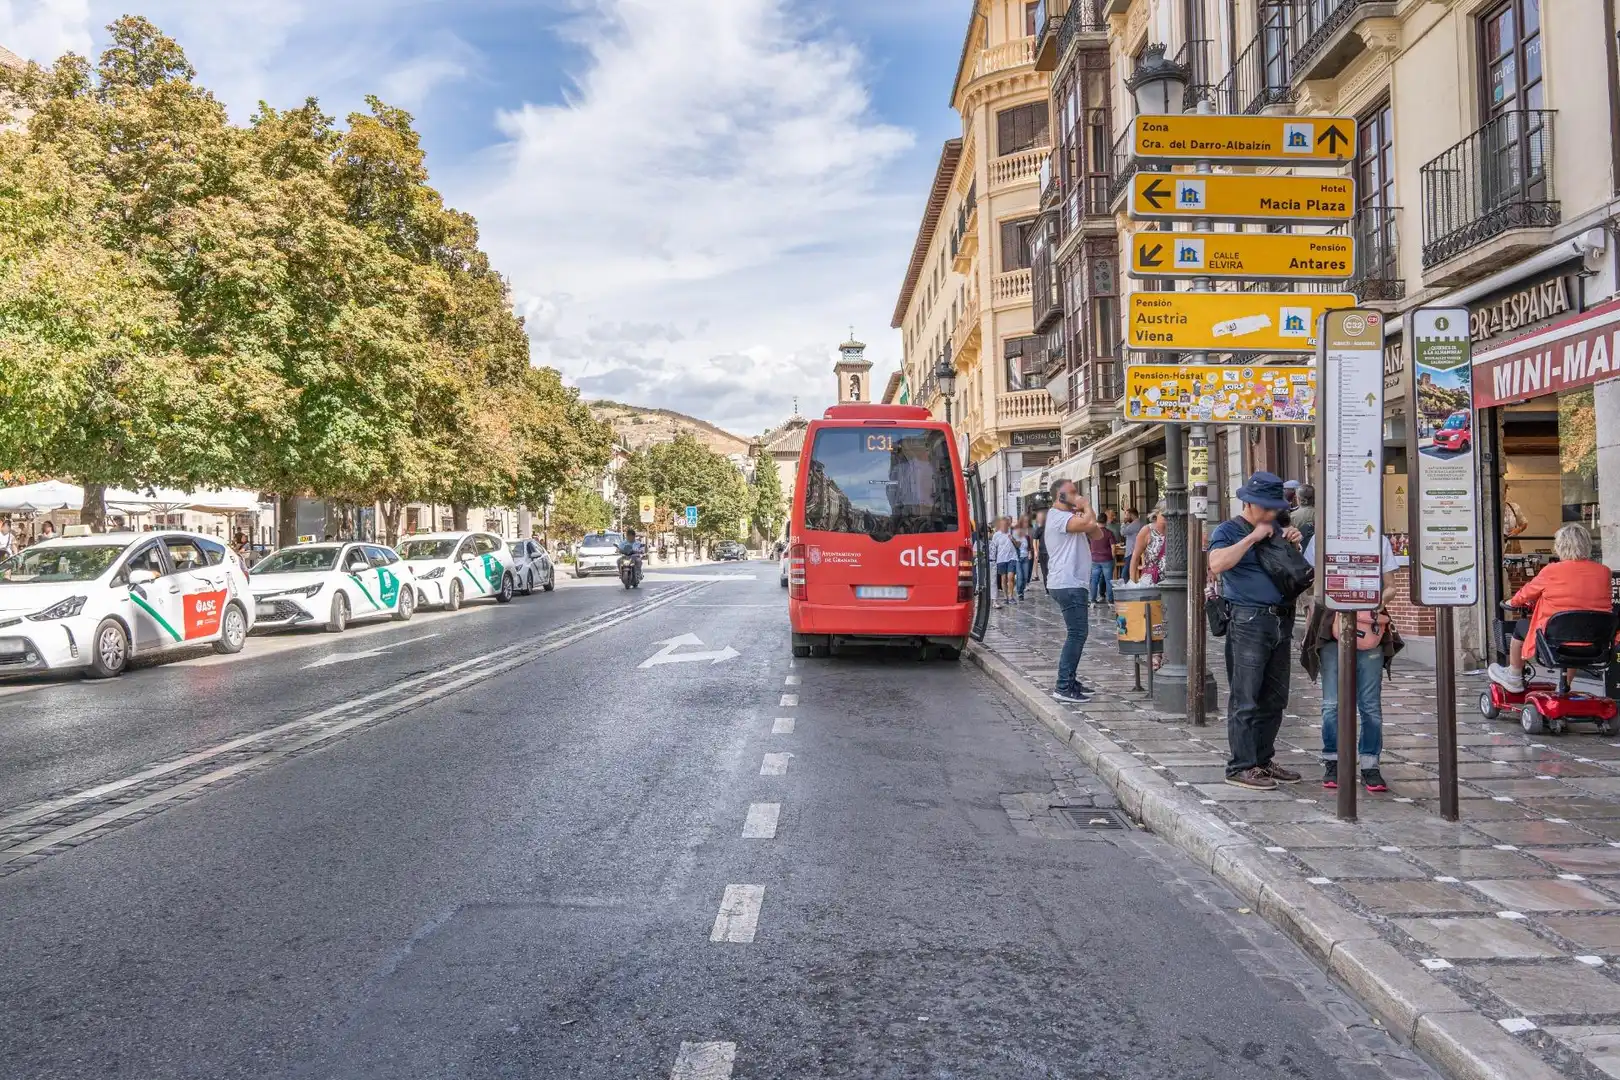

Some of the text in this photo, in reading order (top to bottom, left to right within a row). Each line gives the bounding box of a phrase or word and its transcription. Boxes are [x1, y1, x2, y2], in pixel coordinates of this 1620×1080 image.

[1142, 122, 1169, 132] Zona
[1142, 139, 1271, 151] Cra. del Darro-Albaizín
[1320, 184, 1346, 193] Hotel
[1306, 200, 1346, 211] Plaza
[1309, 243, 1347, 252] Pensión
[1213, 251, 1240, 260] CALLE
[1208, 261, 1244, 269] ELVIRA
[1289, 257, 1346, 270] Antares
[1136, 298, 1172, 307] Pensión
[1501, 276, 1569, 332] ESPAÑA
[1136, 312, 1188, 325] Austria
[1136, 330, 1174, 342] Viena
[1133, 371, 1204, 380] Pensión-Hostal
[1133, 384, 1188, 397] Veeia
[866, 435, 894, 451] C31
[899, 545, 957, 567] alsa
